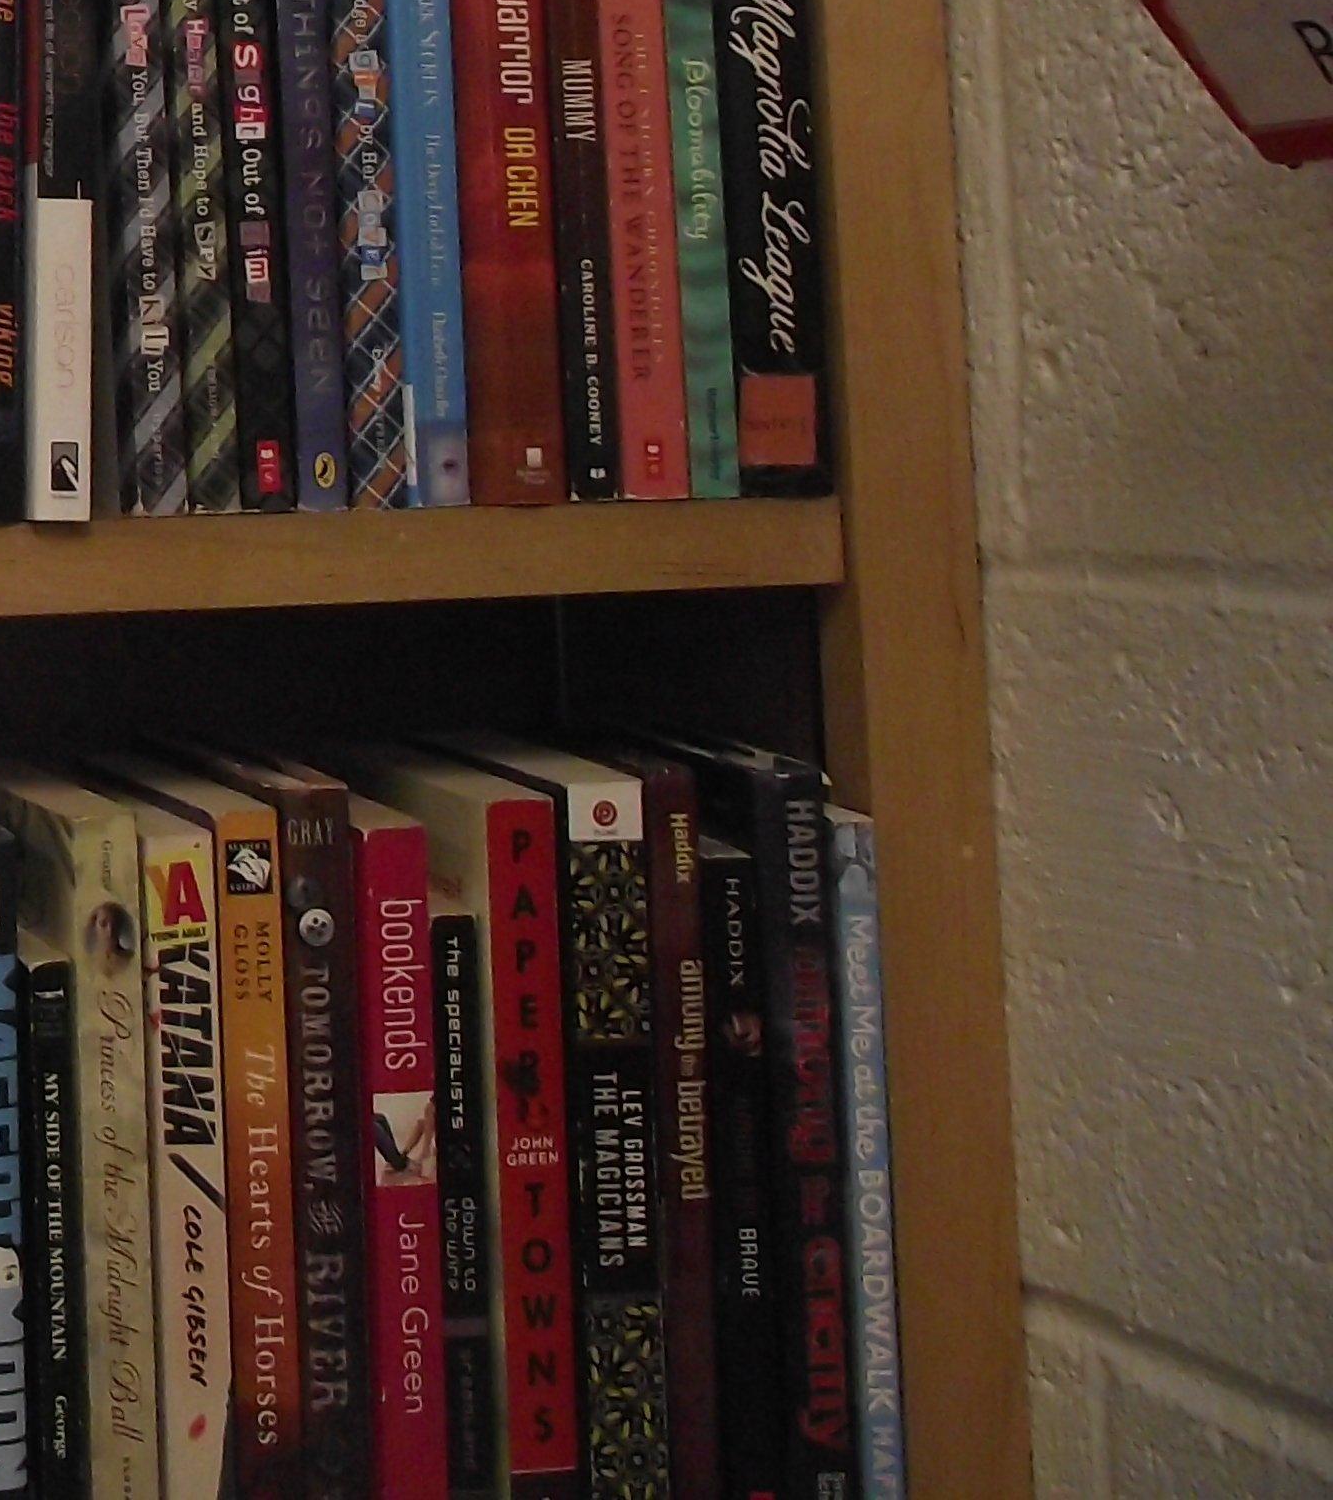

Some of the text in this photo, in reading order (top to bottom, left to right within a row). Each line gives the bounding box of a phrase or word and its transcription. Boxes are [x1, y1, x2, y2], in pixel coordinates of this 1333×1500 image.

[503, 126, 537, 158] DA
[505, 164, 539, 228] CHEN
[738, 192, 811, 356] League
[234, 924, 250, 1002] GLOSS
[256, 921, 273, 1002] MOLLY
[724, 878, 744, 987] HADDIX
[379, 899, 429, 1414] bookends Jane Green
[511, 1136, 554, 1150] JOHN
[592, 1071, 625, 1268] THE MAGICIANS
[621, 1090, 648, 1248] LEV GROSSMAN
[241, 1044, 285, 1446] The Hearts of Horses
[738, 1228, 761, 1298] BRAVE
